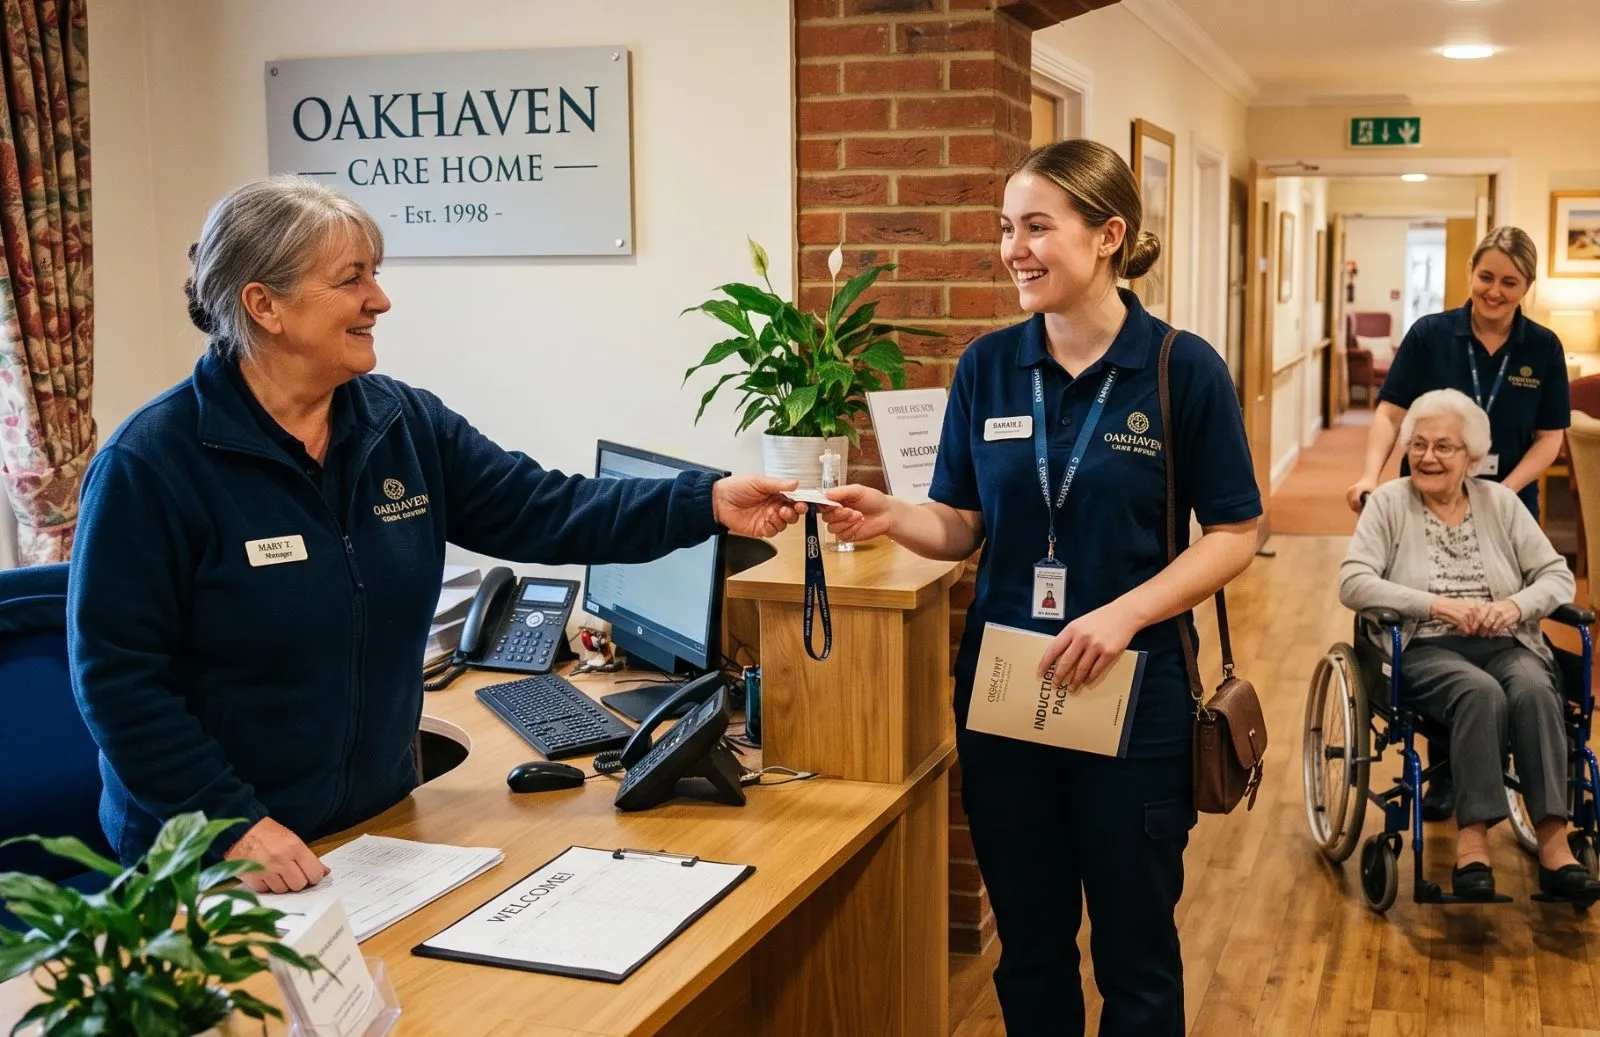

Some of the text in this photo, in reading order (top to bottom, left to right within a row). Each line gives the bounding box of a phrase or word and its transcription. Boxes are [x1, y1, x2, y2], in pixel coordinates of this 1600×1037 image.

[292, 86, 599, 142] OAKHAVEN
[348, 154, 544, 186] CARE HOME
[404, 203, 489, 224] Est. 1998
[900, 444, 940, 457] WELCOM
[1104, 432, 1162, 451] OAKHAVEN
[257, 540, 294, 552] MARY T.
[486, 872, 576, 922] WELCOME!
